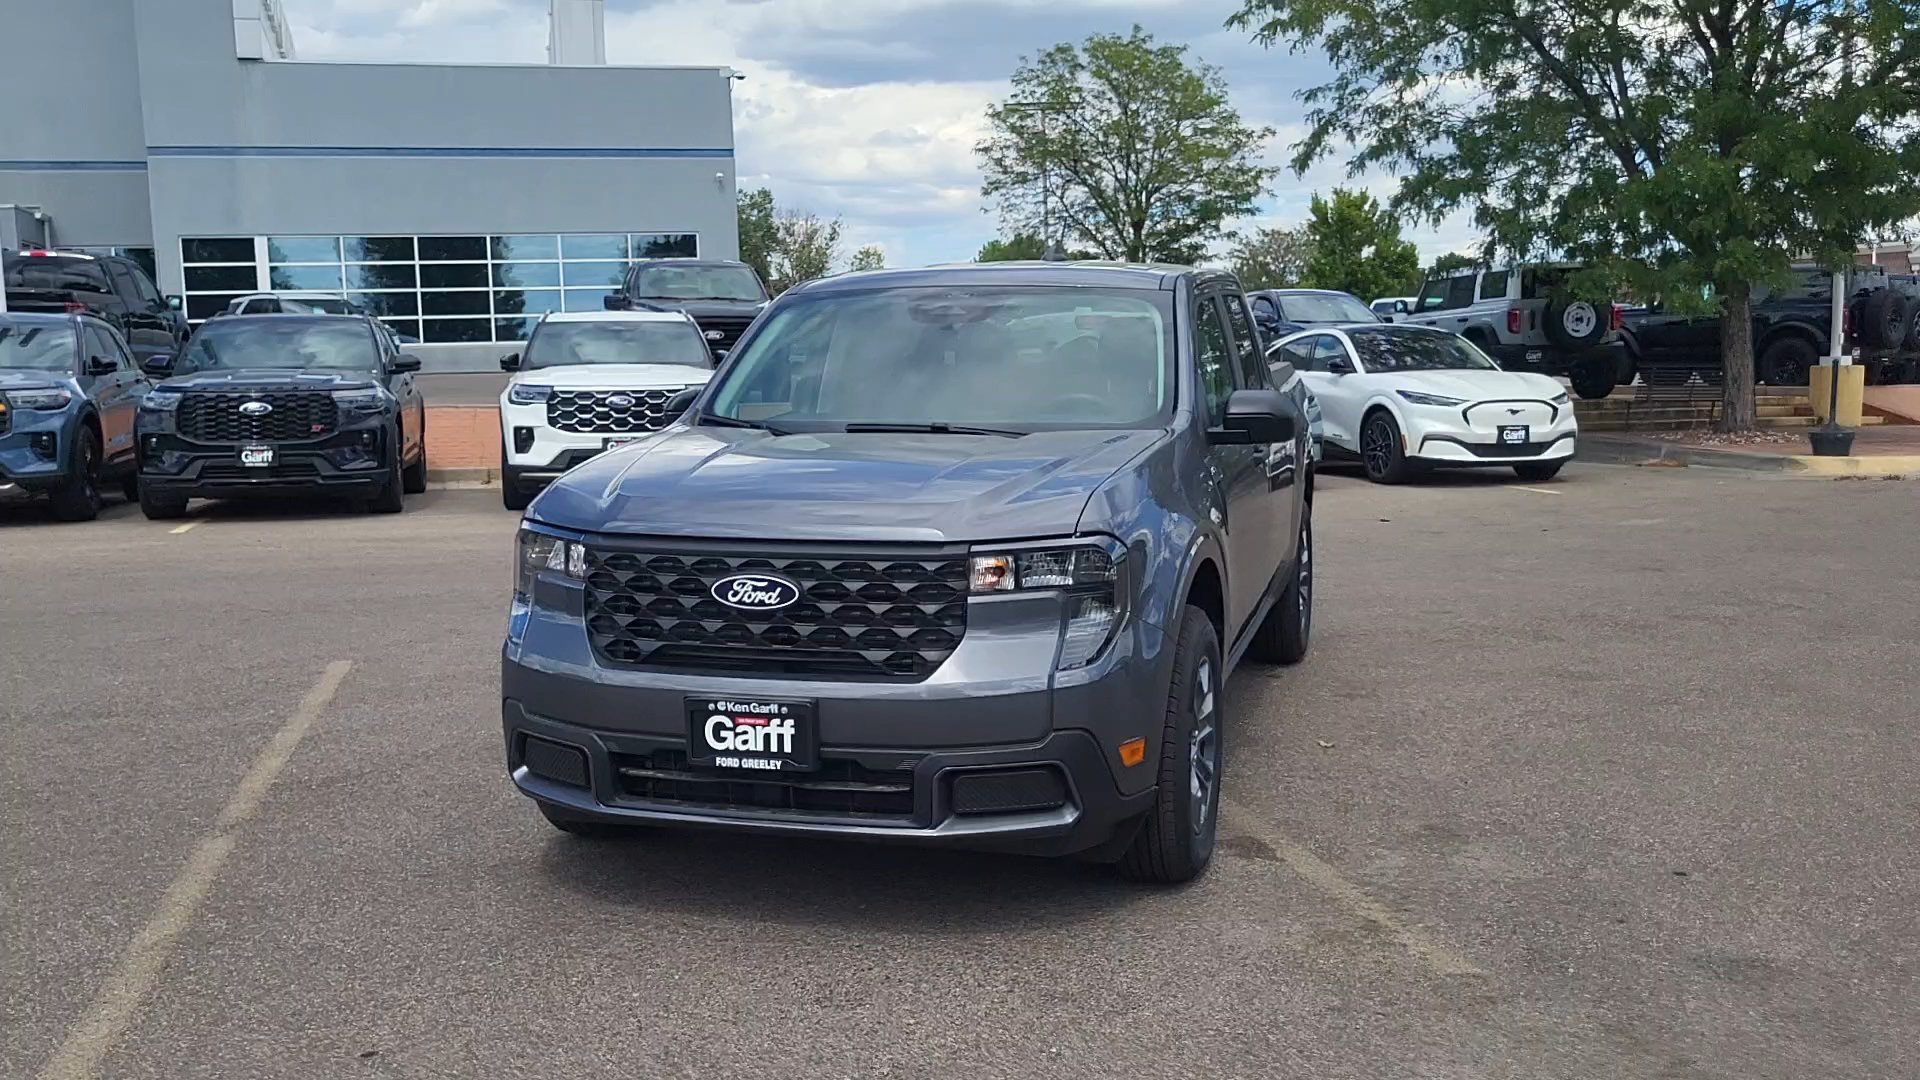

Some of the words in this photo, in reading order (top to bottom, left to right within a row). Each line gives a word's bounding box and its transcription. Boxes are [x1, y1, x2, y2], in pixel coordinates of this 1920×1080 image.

[241, 450, 274, 463] Garff
[727, 579, 782, 605] Ford
[727, 702, 749, 713] Ken
[750, 703, 779, 714] Garff
[704, 715, 796, 754] Garff
[715, 757, 740, 768] FORD
[741, 758, 782, 770] GREELEY
